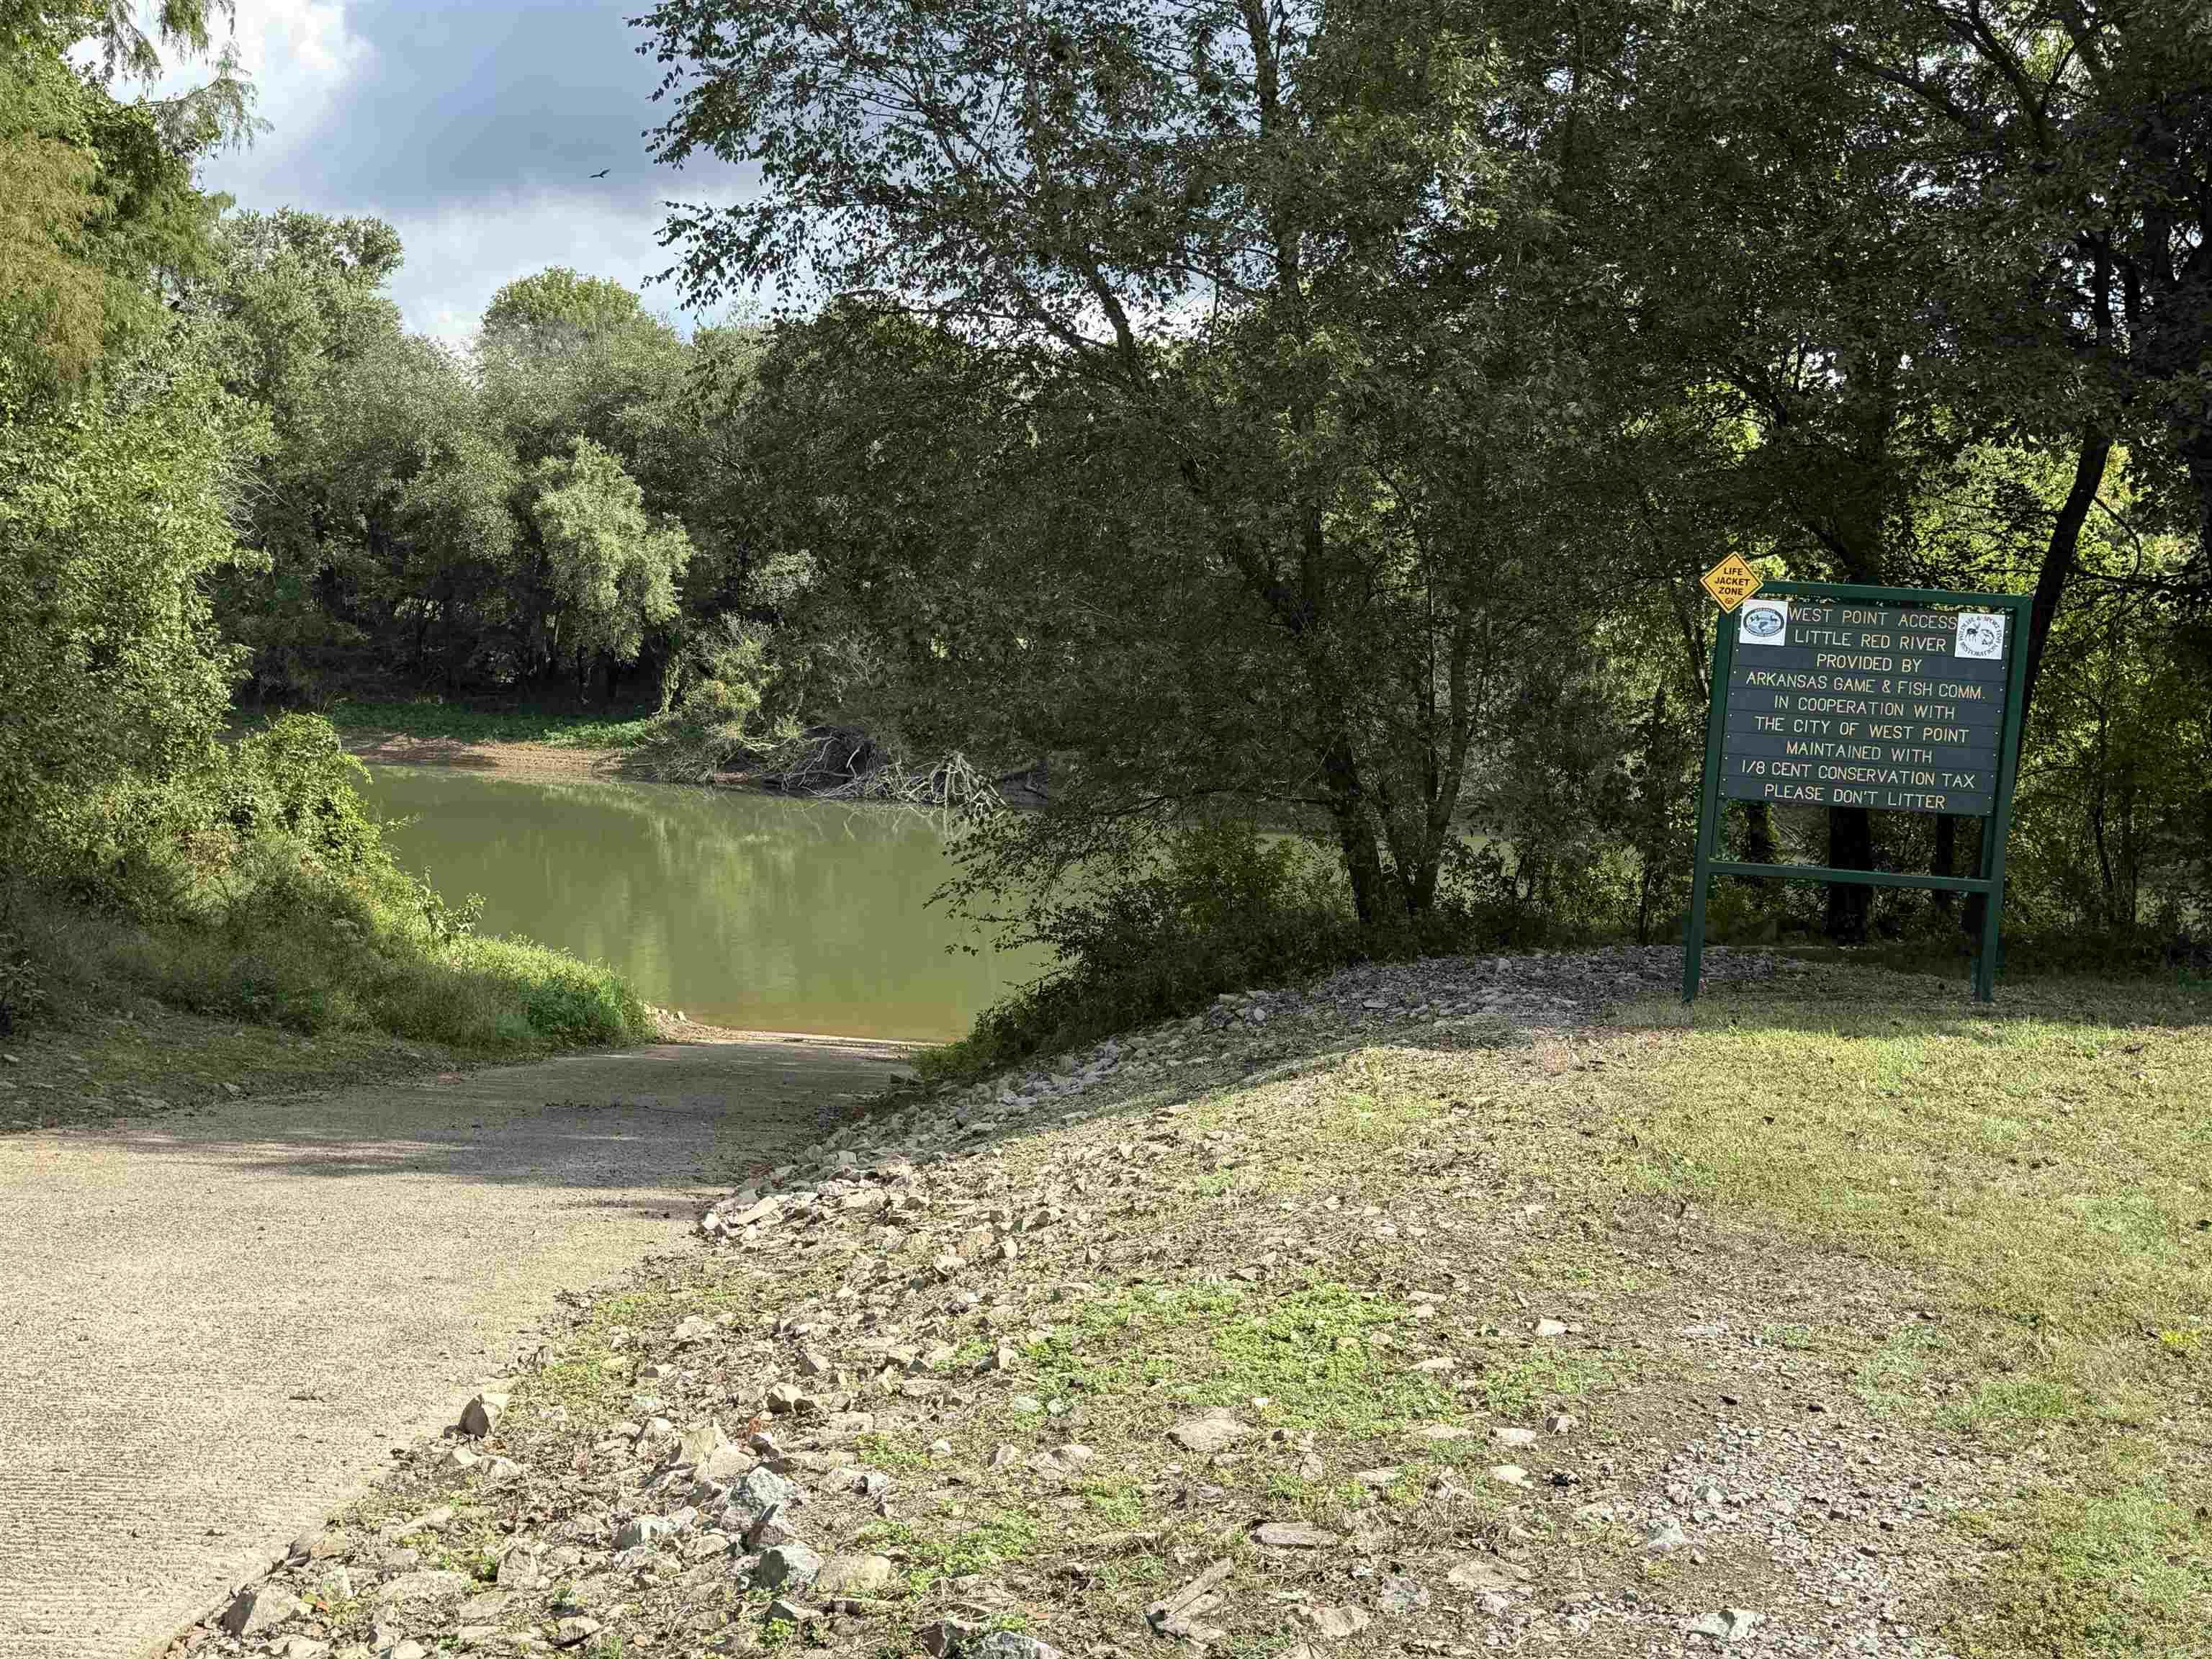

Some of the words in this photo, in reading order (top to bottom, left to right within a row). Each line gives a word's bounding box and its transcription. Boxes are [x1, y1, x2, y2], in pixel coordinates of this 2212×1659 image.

[1714, 577, 1750, 586] JACKET
[1723, 567, 1743, 576] LIFE
[1718, 587, 1743, 595] ZONE
[1788, 608, 1833, 623] WEST
[1843, 611, 1889, 626] POINT
[1898, 613, 1959, 629] ACCESS
[1794, 630, 1853, 647] LITTLE
[1861, 634, 1890, 649] RED
[1899, 636, 1946, 652] RIVER
[1816, 654, 1892, 672] PROVIDED
[1902, 658, 1923, 673] BY
[1746, 672, 1828, 689] ARKANSAS
[1834, 677, 1875, 693] GAME
[1881, 679, 1891, 693] &
[1897, 680, 1933, 696] FISH
[1938, 683, 1986, 700] COMM.
[1774, 695, 1789, 709] IN
[1798, 697, 1904, 716] COOPERATION
[1913, 704, 1955, 719] WITH
[1754, 716, 1785, 732] THE
[1794, 719, 1831, 734] CITY
[1840, 722, 1860, 736] OF
[1869, 724, 1914, 739] WEST
[1923, 727, 1969, 743] POINT
[1786, 740, 1881, 760] MAINTAINED
[1891, 747, 1933, 763] WITH
[1741, 760, 1766, 775] 1/8
[1771, 761, 1812, 778] CENT
[1818, 765, 1936, 786] CONSERVATION
[1941, 773, 1976, 788] TAX
[1764, 783, 1825, 801] PLEASE
[1833, 788, 1879, 804] DON'T
[1887, 792, 1946, 809] LITTER
